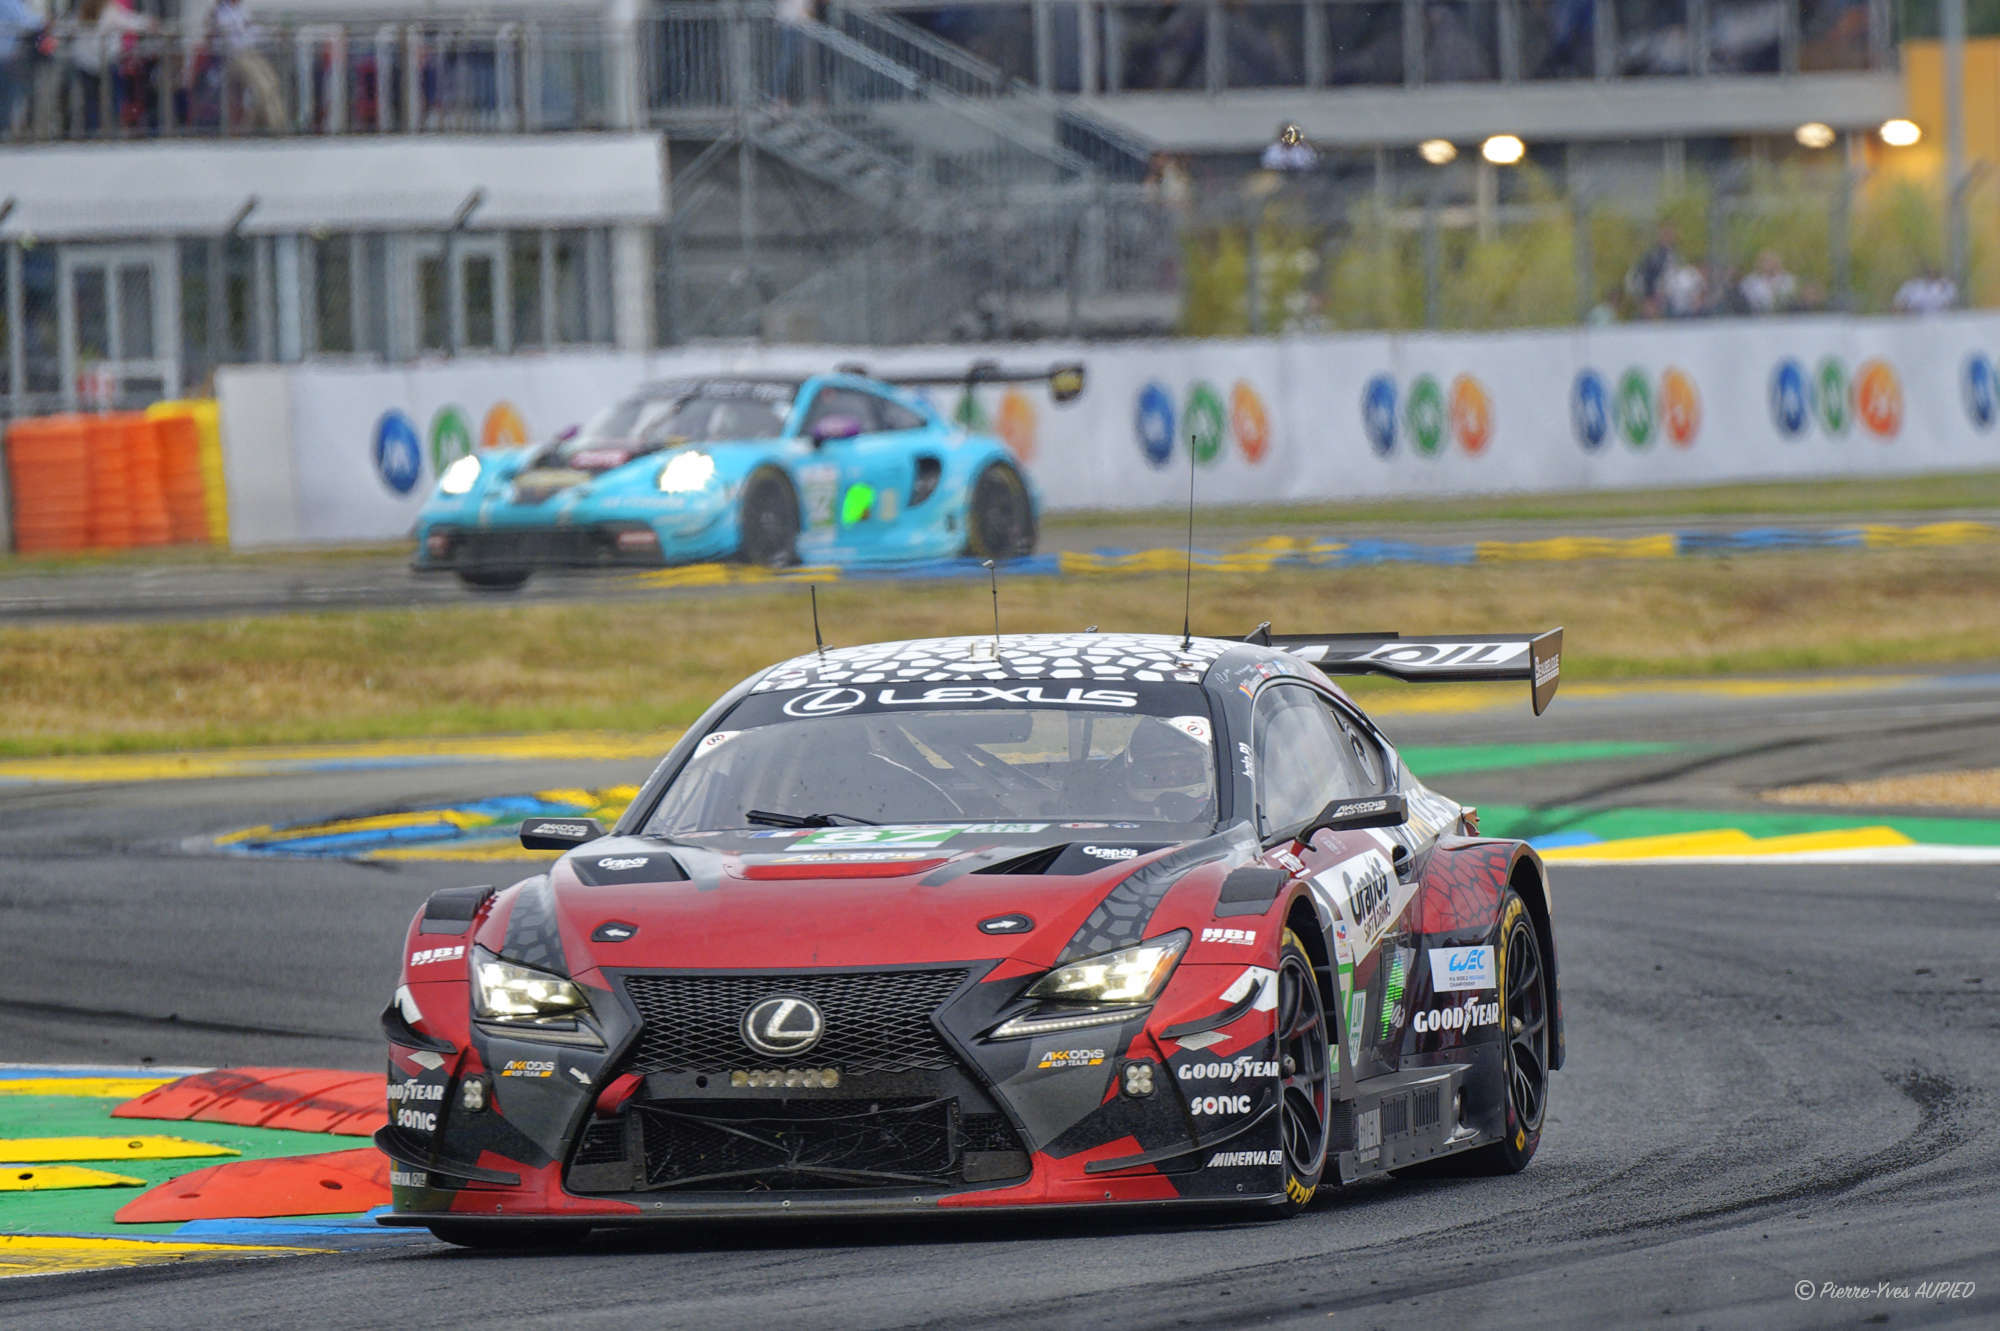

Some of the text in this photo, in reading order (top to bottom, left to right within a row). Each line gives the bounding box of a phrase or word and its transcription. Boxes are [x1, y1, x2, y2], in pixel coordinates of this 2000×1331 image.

[1371, 645, 1502, 665] OIL
[878, 687, 1139, 707] LEXUS
[812, 830, 950, 844] 87
[1449, 949, 1486, 972] WEC
[1413, 997, 1499, 1034] GOODYEAR
[1178, 1057, 1279, 1082] GOODYEAR
[1191, 1095, 1251, 1115] SONIC
[397, 1108, 436, 1131] SONIC
[1207, 1150, 1282, 1167] MINERVA OIL
